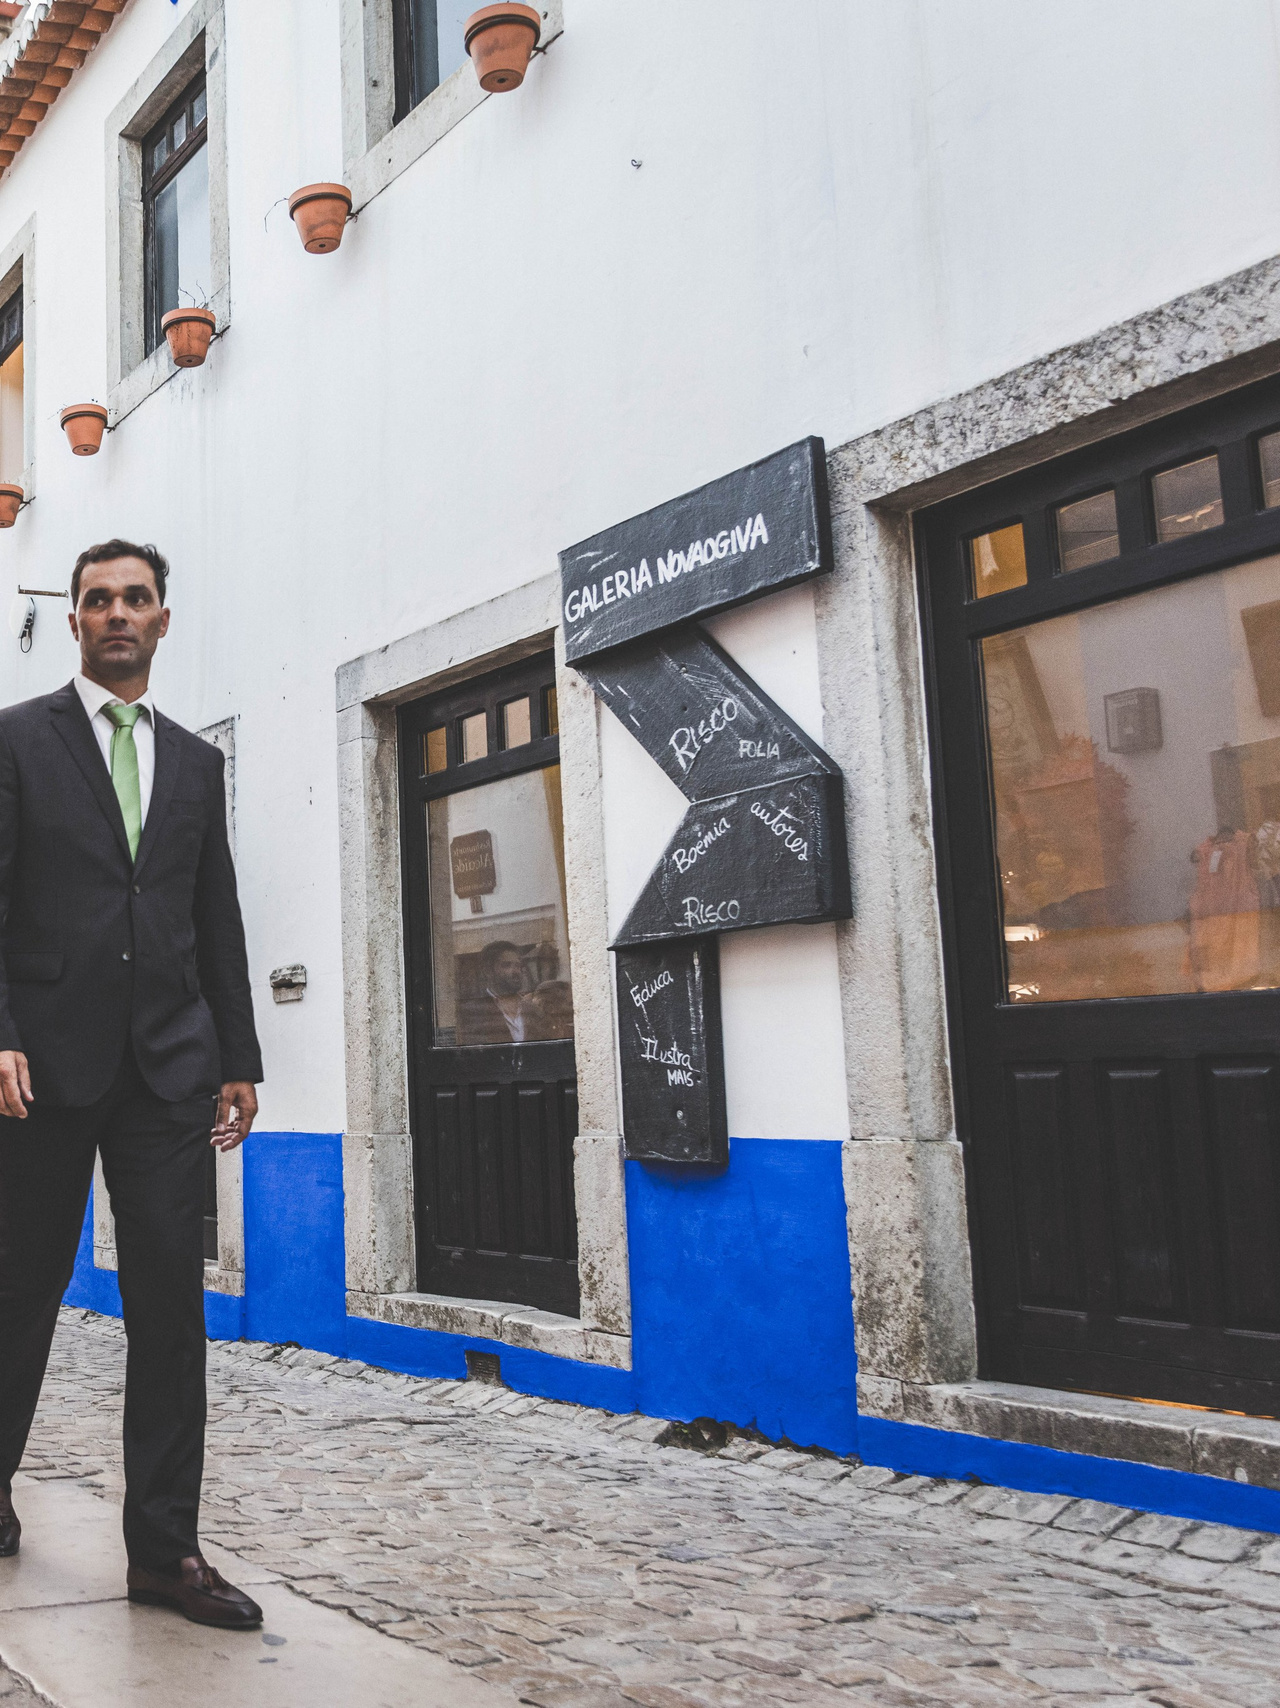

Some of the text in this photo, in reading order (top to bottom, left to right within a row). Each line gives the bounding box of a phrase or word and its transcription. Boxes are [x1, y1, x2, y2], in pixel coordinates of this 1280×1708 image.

[564, 558, 653, 623] GALERIA
[738, 739, 780, 760] FOLIA
[673, 816, 731, 874] Boémia
[750, 801, 809, 862] autores
[630, 970, 674, 1007] Educa
[666, 1069, 694, 1087] MAIS
